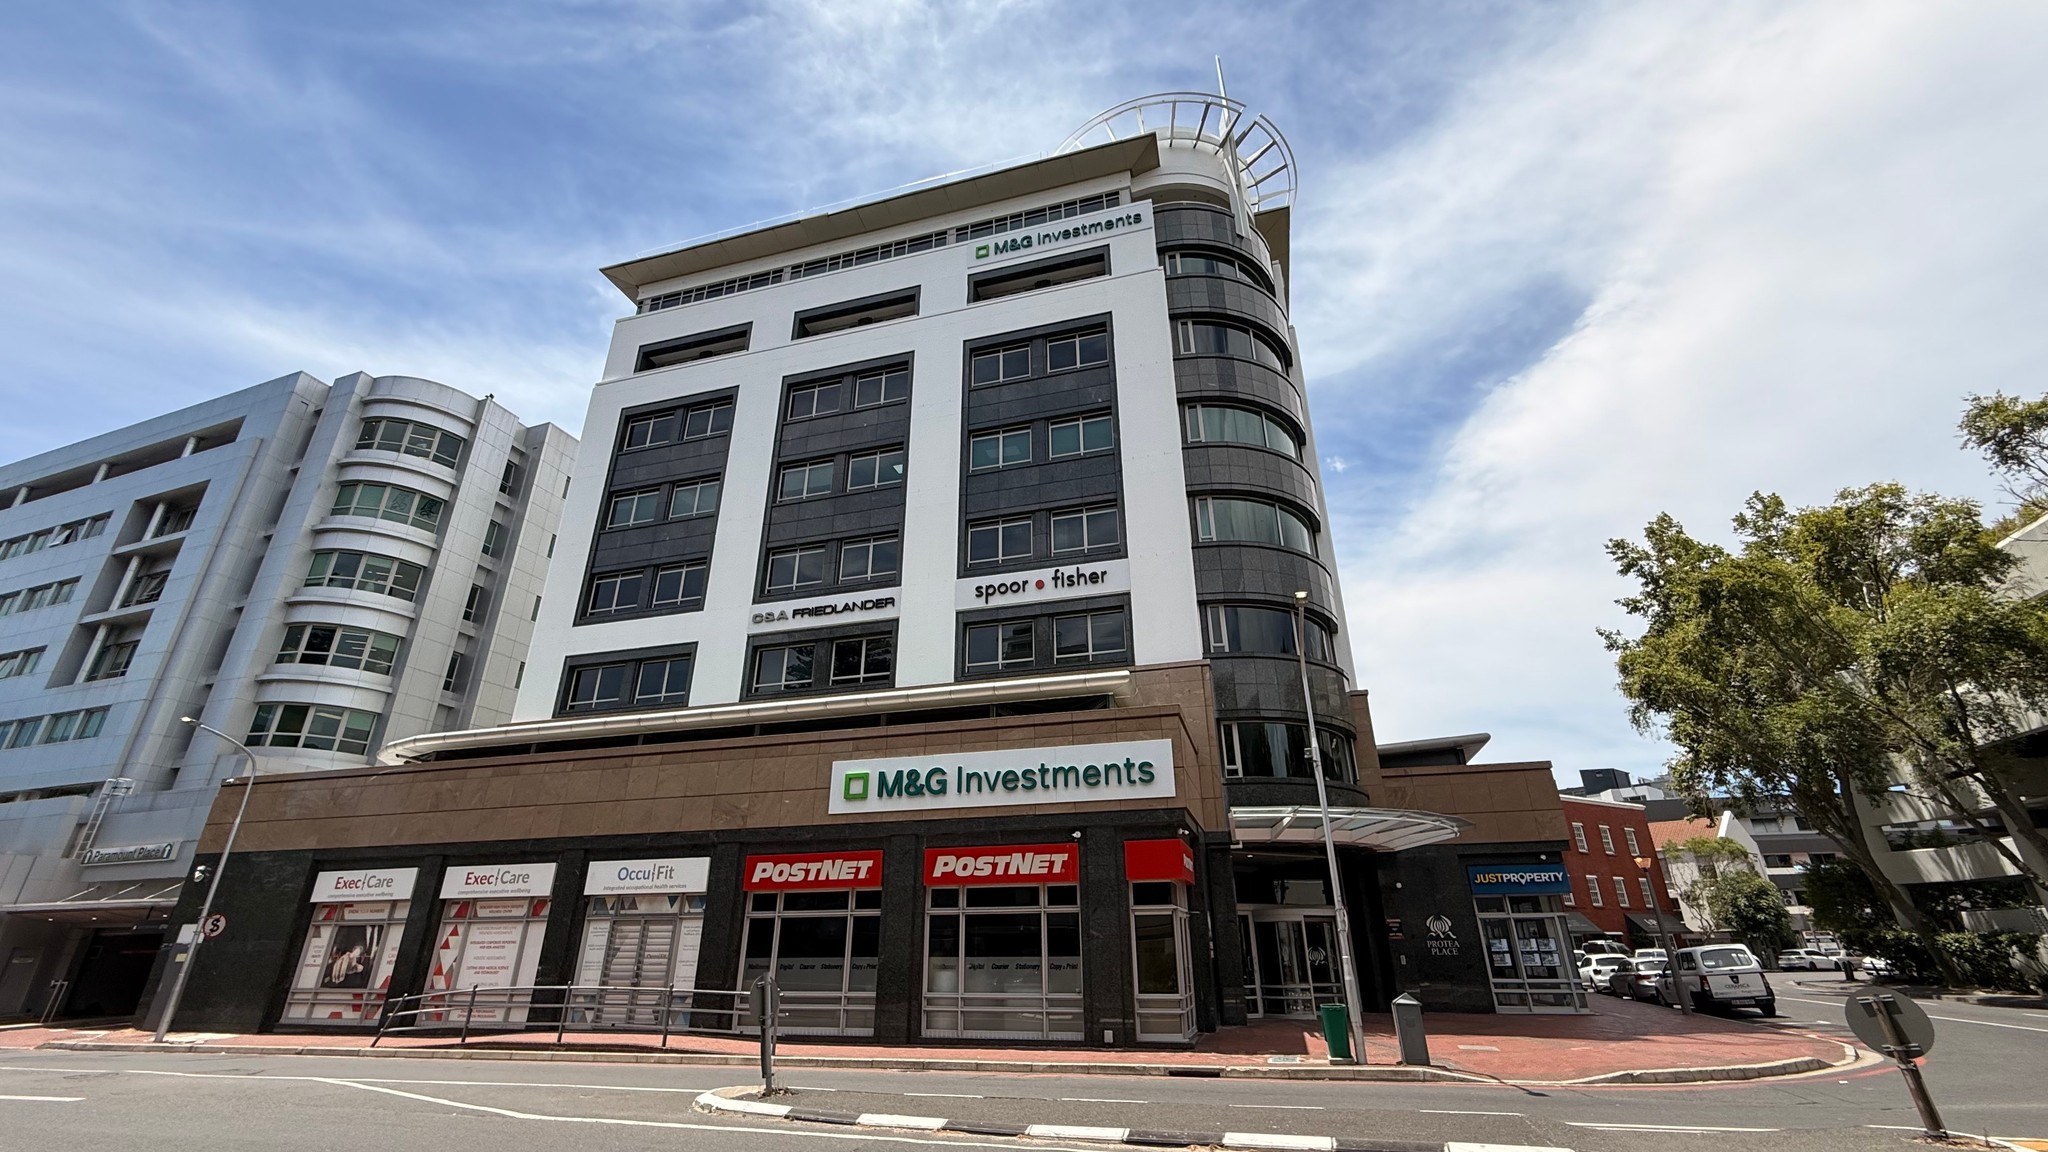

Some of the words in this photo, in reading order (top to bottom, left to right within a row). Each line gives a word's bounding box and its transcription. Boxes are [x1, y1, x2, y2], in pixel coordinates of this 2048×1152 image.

[994, 235, 1033, 255] M&G
[1037, 212, 1142, 246] Investments
[975, 579, 1029, 604] spoor
[1051, 566, 1107, 589] fisher
[752, 609, 789, 624] C&A
[792, 597, 895, 619] FRIEDLANDER
[876, 766, 948, 798] M&G
[957, 757, 1156, 794] Investments
[94, 849, 137, 862] Paramount
[137, 847, 161, 858] Place
[1427, 940, 1460, 948] PROTEA
[1431, 948, 1459, 956] PLACE
[1050, 963, 1062, 971] Copy
